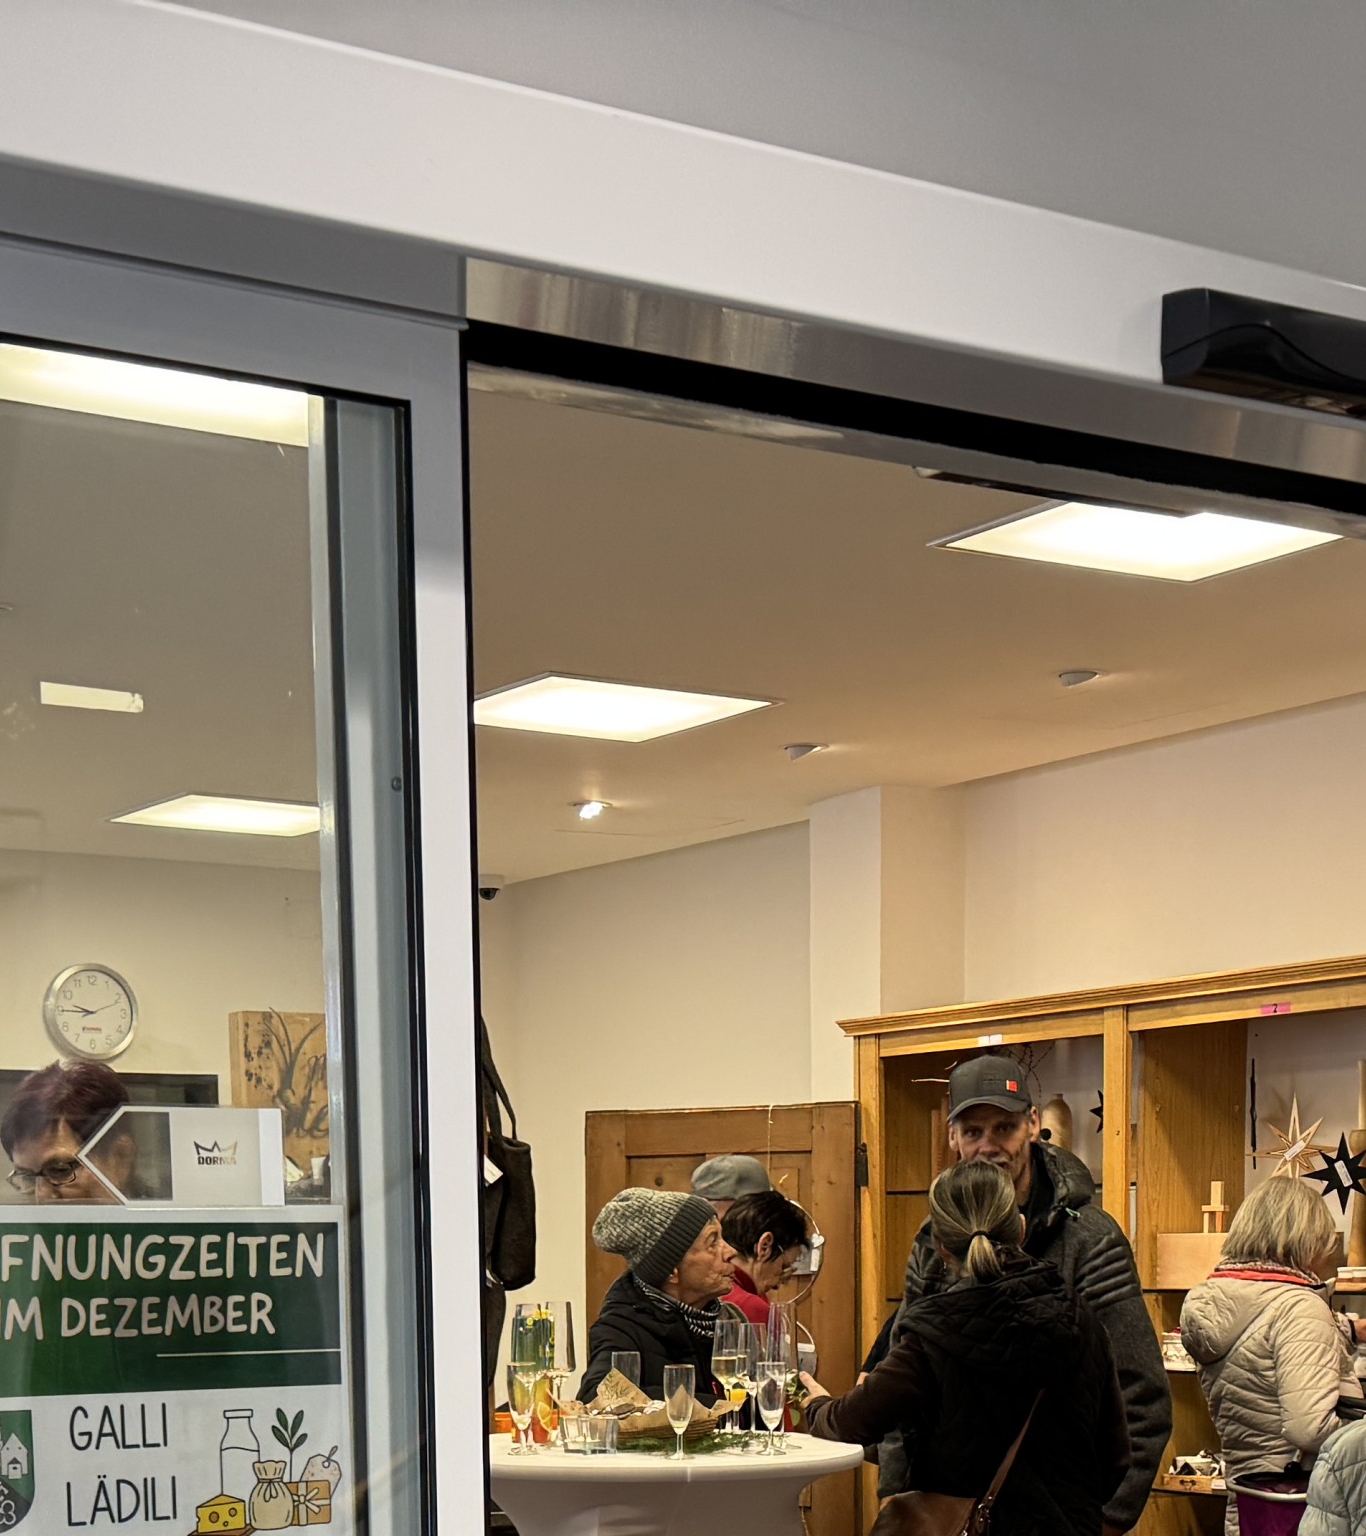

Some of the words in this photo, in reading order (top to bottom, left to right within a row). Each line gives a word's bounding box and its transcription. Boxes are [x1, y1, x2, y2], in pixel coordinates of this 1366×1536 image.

[60, 1292, 276, 1338] DEZEMBER
[69, 1403, 168, 1451] GALLI
[67, 1474, 177, 1527] LÄDILI
